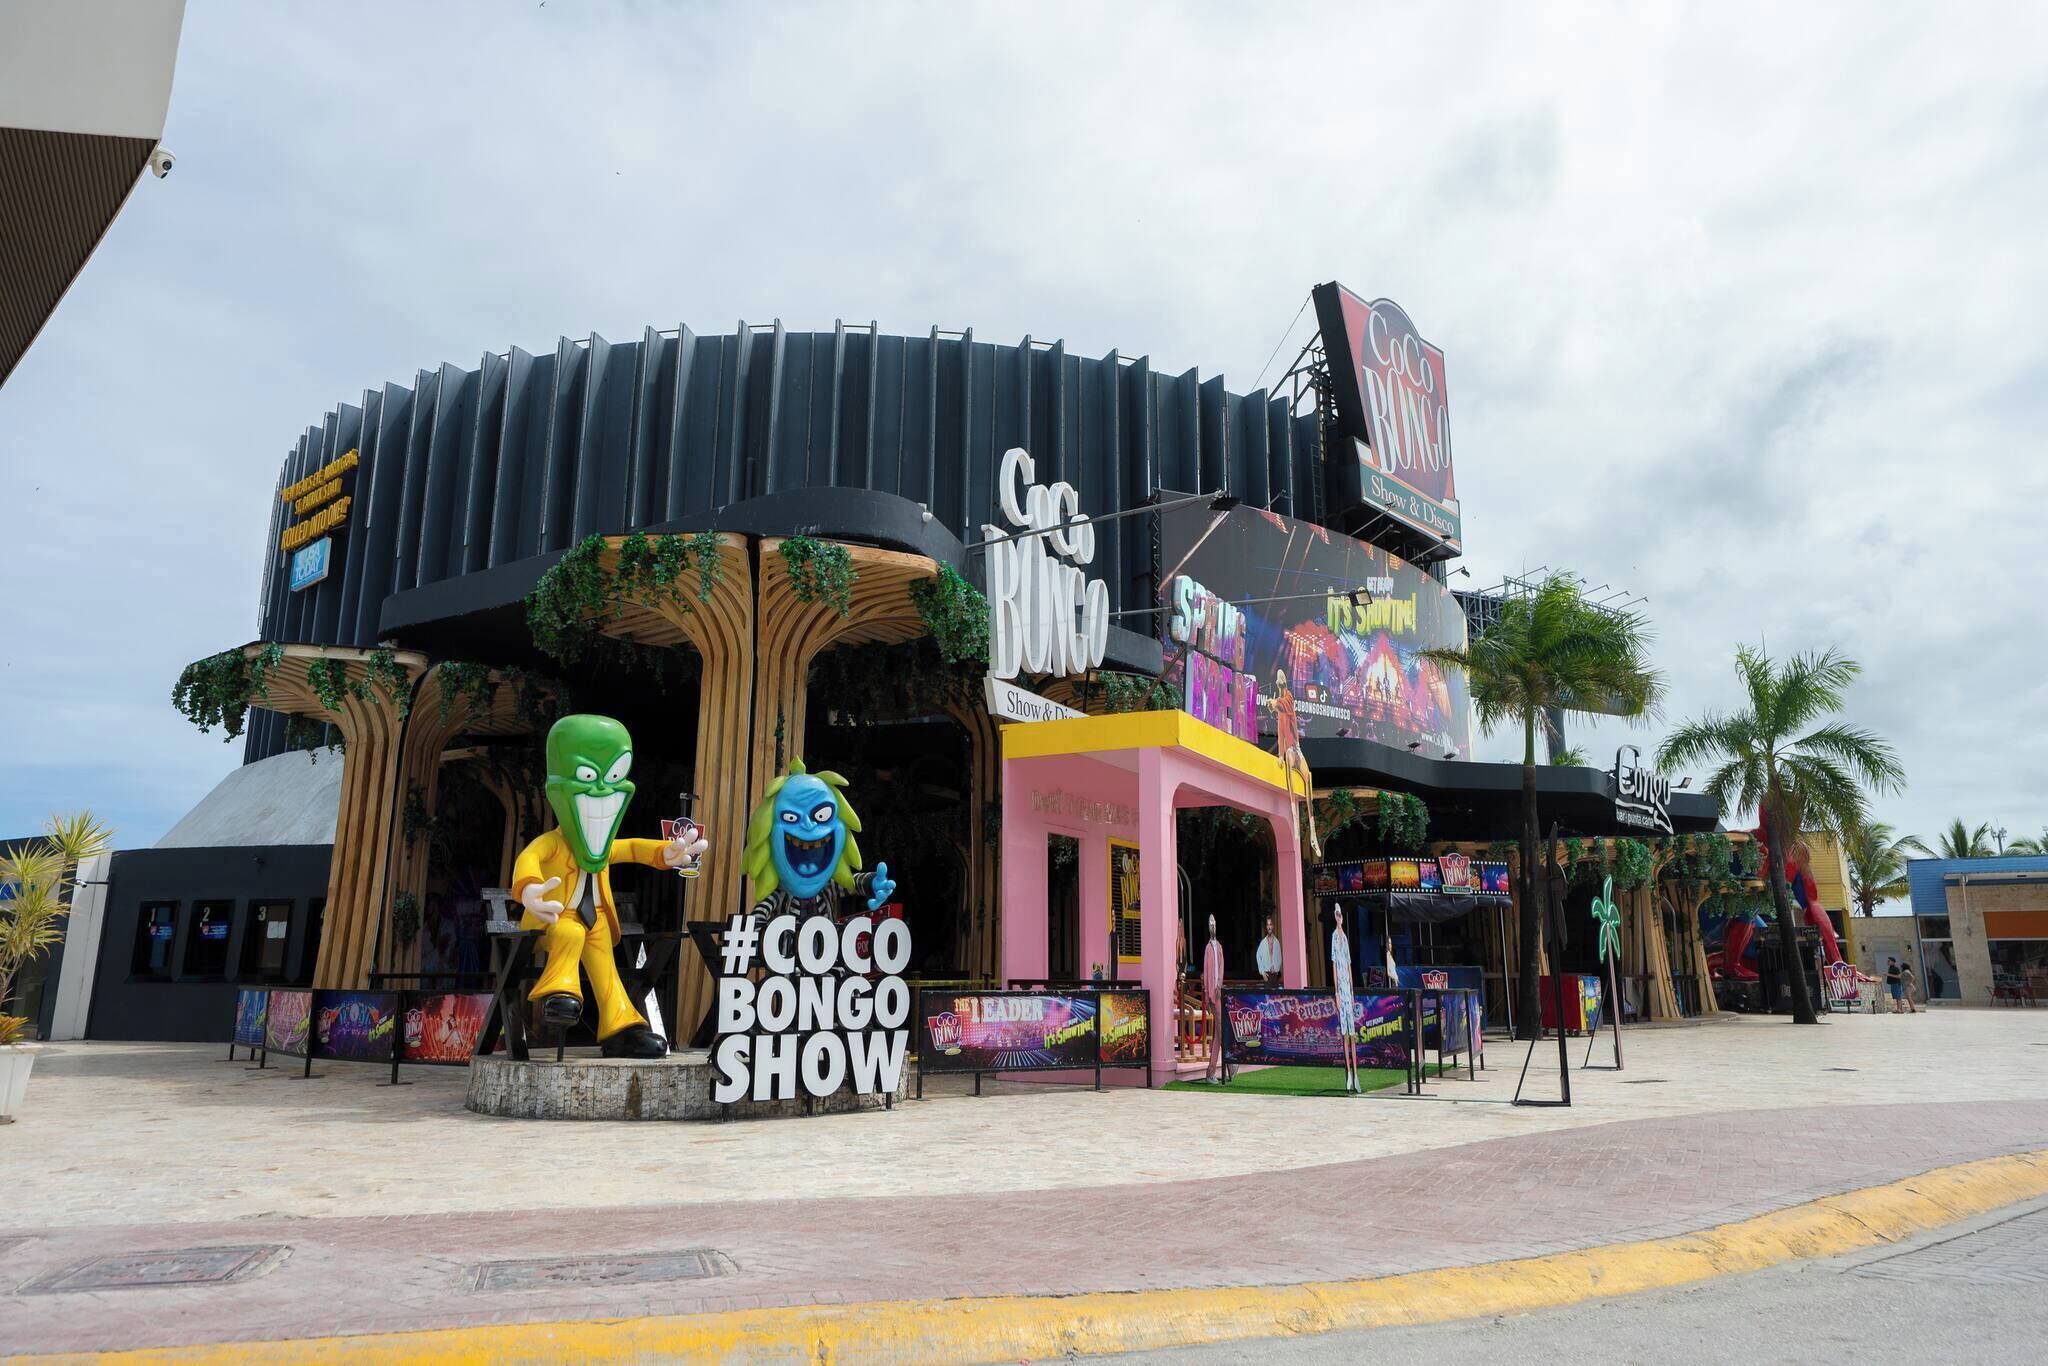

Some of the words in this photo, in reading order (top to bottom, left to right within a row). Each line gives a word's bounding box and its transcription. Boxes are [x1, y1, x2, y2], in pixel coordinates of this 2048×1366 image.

[1371, 475, 1407, 512] Show
[1409, 496, 1419, 518] &
[1423, 503, 1454, 537] Disco
[295, 559, 320, 582] TODAY
[1171, 575, 1247, 671] SPRING
[1007, 690, 1041, 721] Show
[1042, 702, 1053, 721] &
[1187, 649, 1259, 744] BREAK
[151, 907, 156, 922] 1
[203, 906, 211, 922] 2
[258, 906, 267, 921] 3
[721, 914, 912, 975] #COCO
[718, 975, 910, 1033] BONGO
[954, 998, 970, 1012] THE
[970, 997, 1044, 1023] LEADER
[1360, 1015, 1403, 1044] SHOWTIME!
[715, 1030, 909, 1104] SHOW
